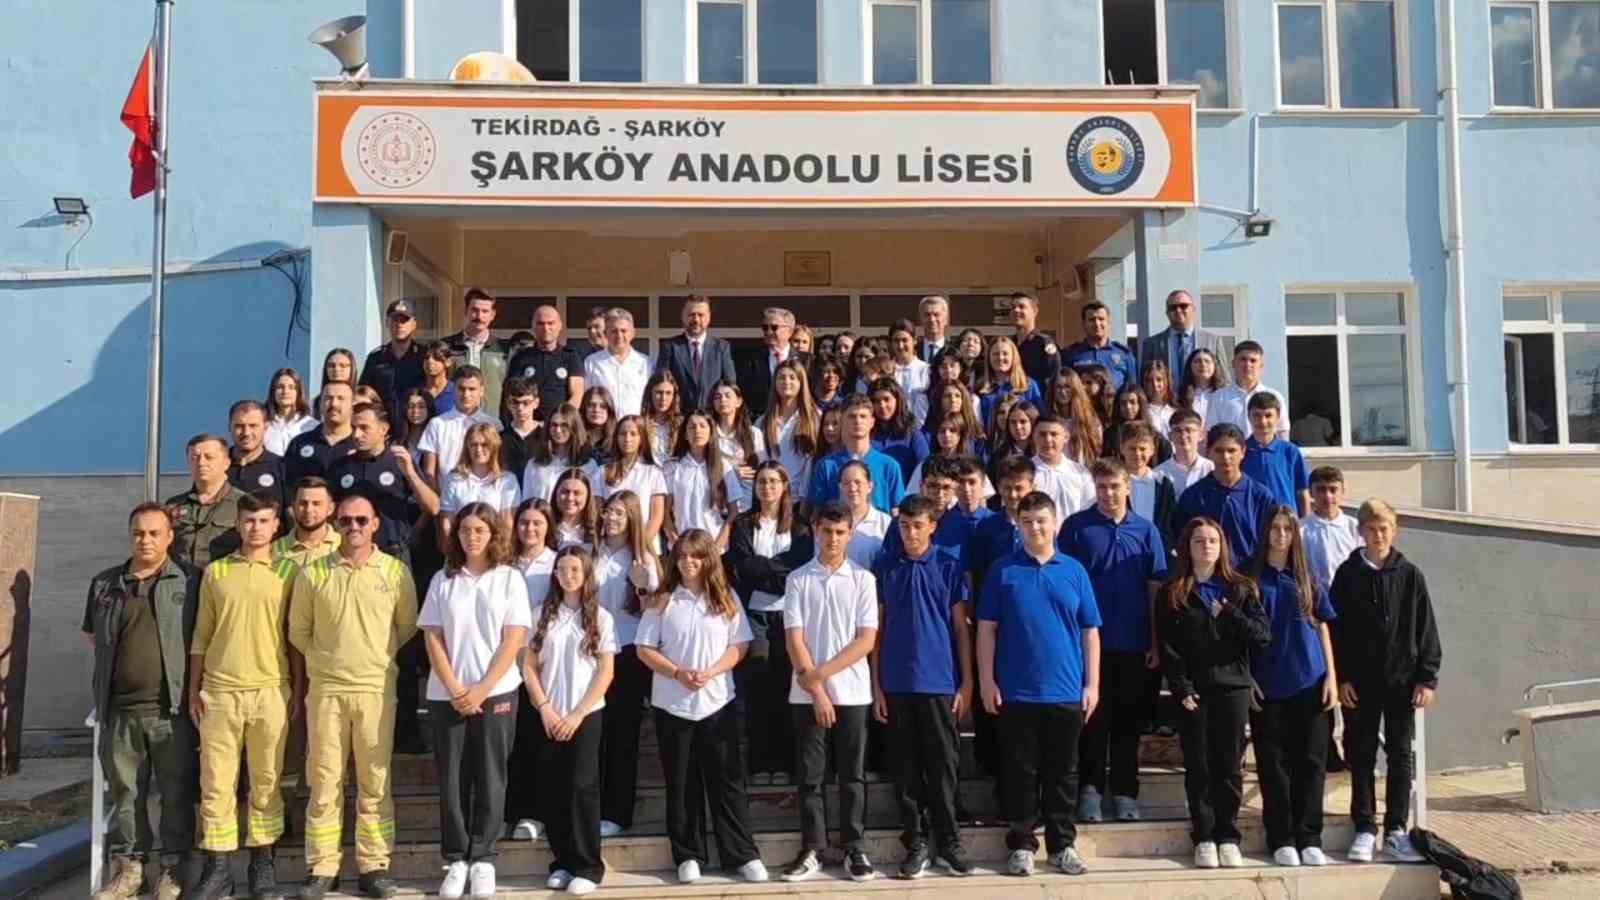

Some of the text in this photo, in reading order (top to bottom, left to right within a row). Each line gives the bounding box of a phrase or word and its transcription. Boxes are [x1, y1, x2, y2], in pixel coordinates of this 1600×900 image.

[471, 114, 601, 137] TEKİRDAĞ
[624, 116, 726, 140] ŞARKÖY
[470, 145, 653, 188] ŞARKÖY
[667, 153, 880, 184] ANADOLU
[897, 146, 1032, 184] LİSESİ
